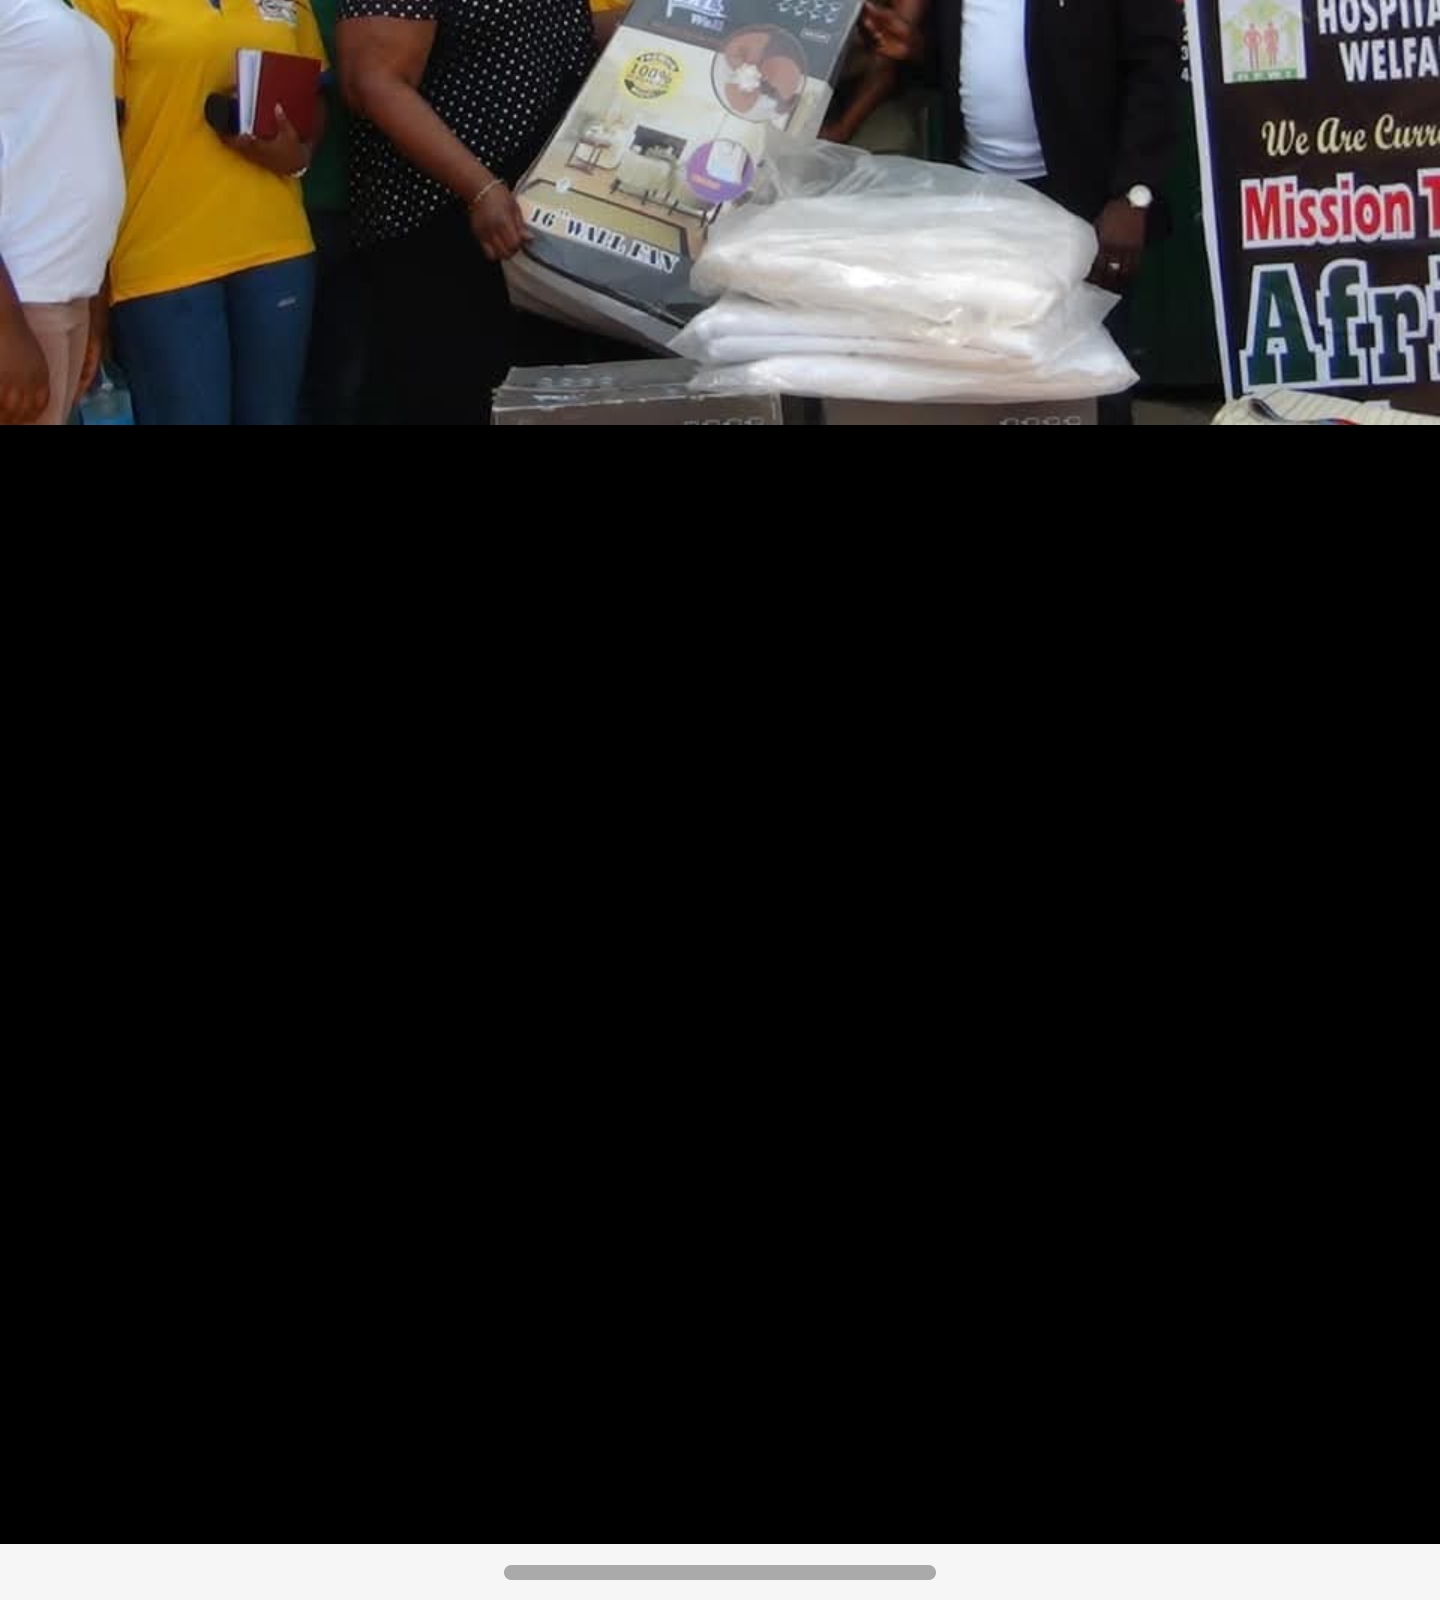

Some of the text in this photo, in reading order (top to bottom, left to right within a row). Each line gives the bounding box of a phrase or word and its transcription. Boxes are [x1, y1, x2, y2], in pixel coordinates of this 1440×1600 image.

[1339, 36, 1440, 83] WELFA
[1261, 119, 1310, 157] We
[1316, 117, 1368, 154] Are
[1242, 174, 1415, 248] Mission
[567, 219, 626, 256] WALL
[627, 239, 680, 274] FAN
